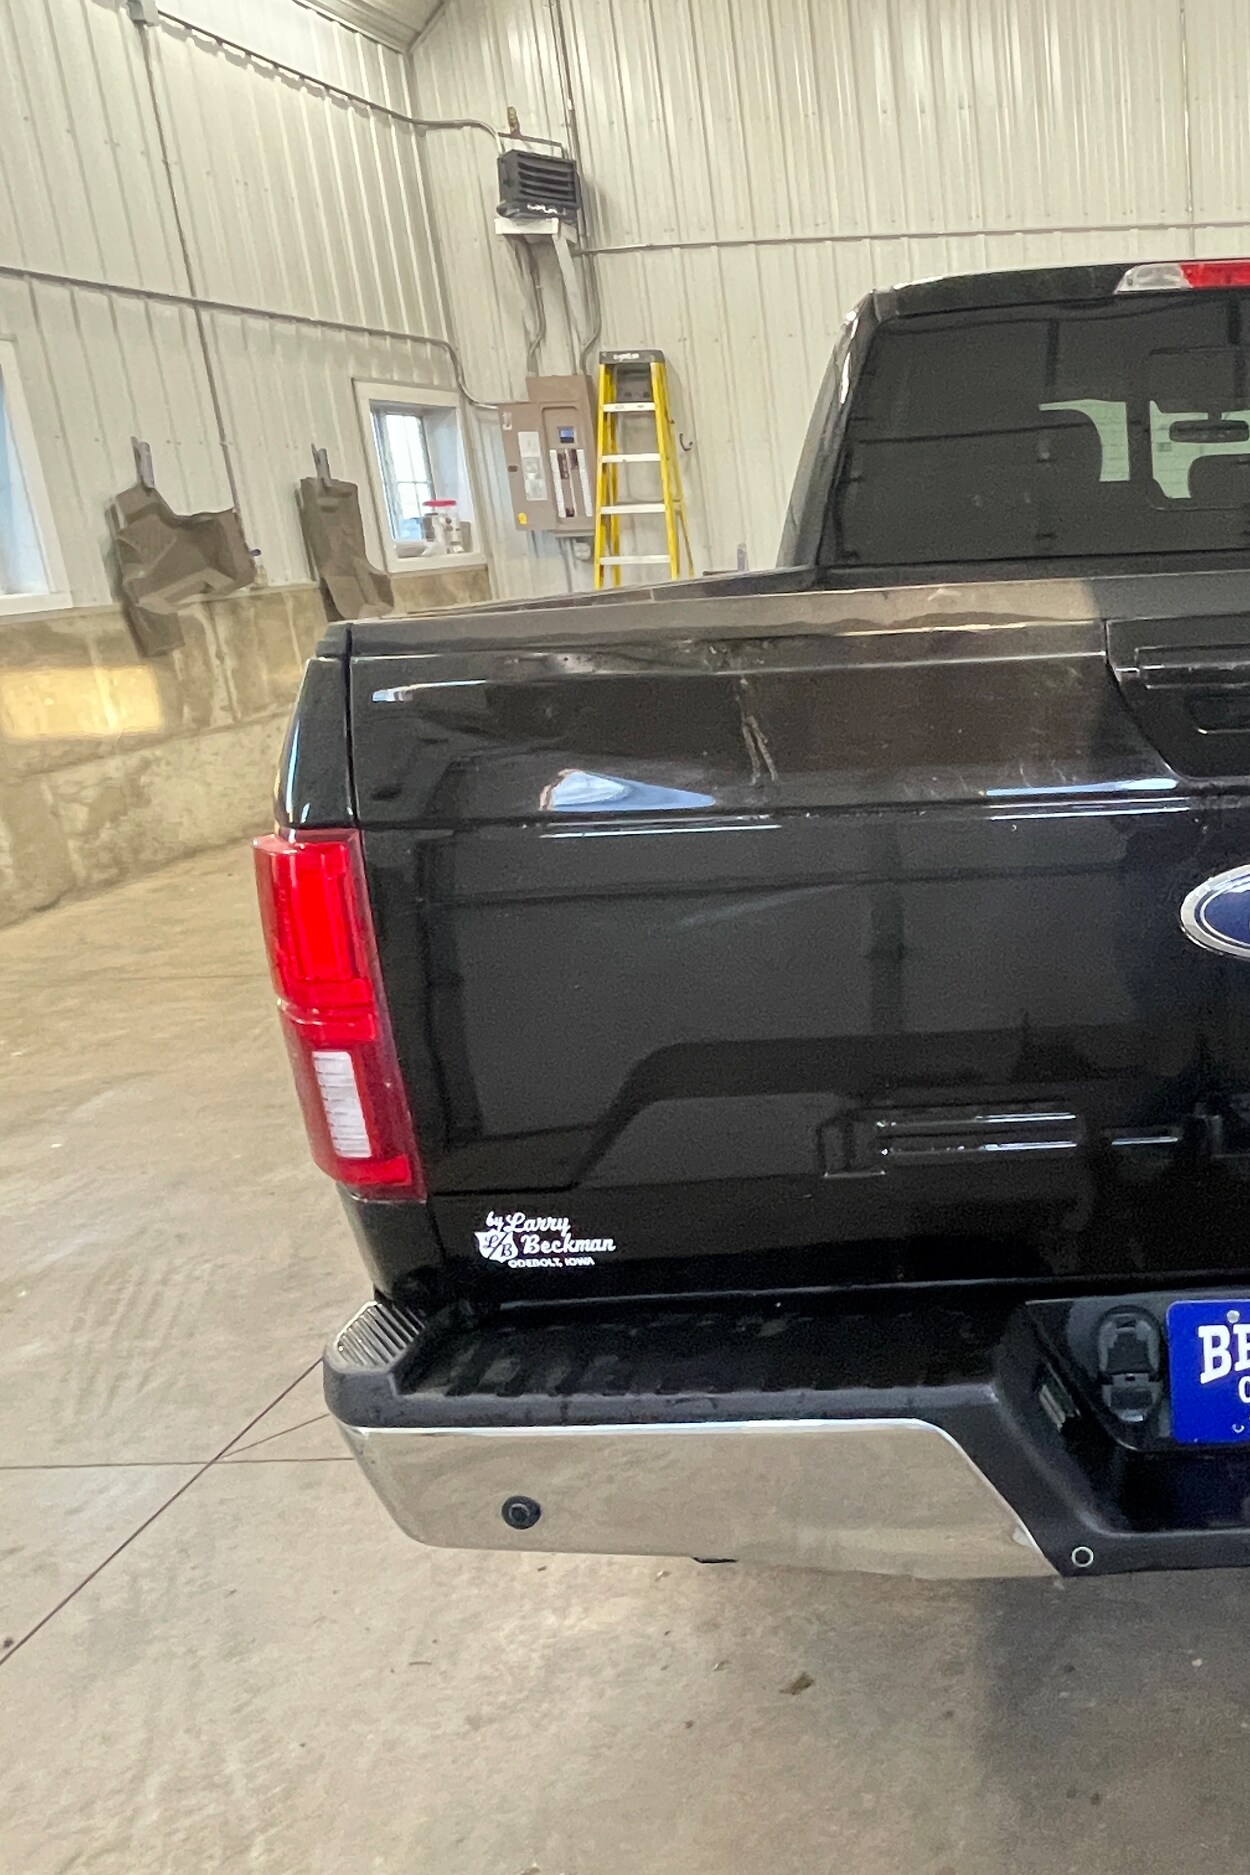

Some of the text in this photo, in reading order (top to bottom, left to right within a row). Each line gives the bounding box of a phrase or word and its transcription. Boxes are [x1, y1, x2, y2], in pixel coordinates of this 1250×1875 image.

[485, 1210, 572, 1238] by Larry
[520, 1232, 617, 1255] Beckman
[564, 1256, 597, 1268] IOWA
